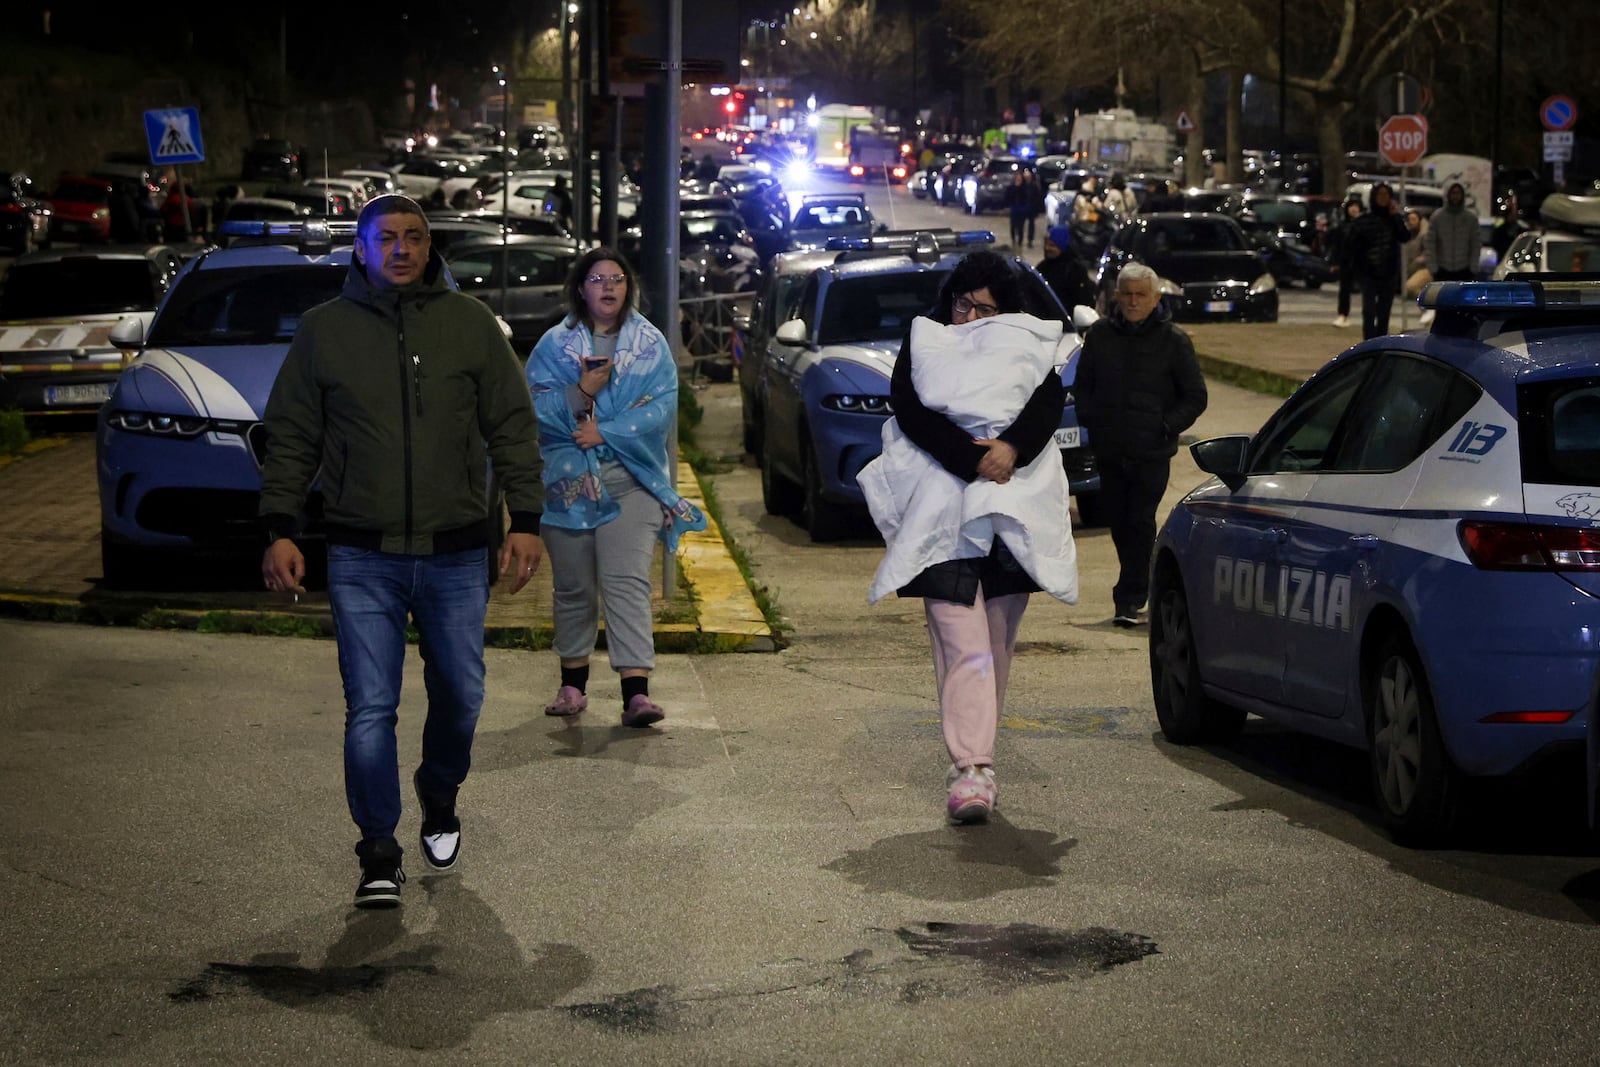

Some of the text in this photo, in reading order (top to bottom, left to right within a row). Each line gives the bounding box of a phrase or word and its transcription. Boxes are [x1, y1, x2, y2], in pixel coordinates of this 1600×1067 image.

[1383, 131, 1423, 151] STOP
[1053, 431, 1078, 445] 8497
[1448, 421, 1507, 456] 113
[1213, 555, 1352, 633] POLIZIA
